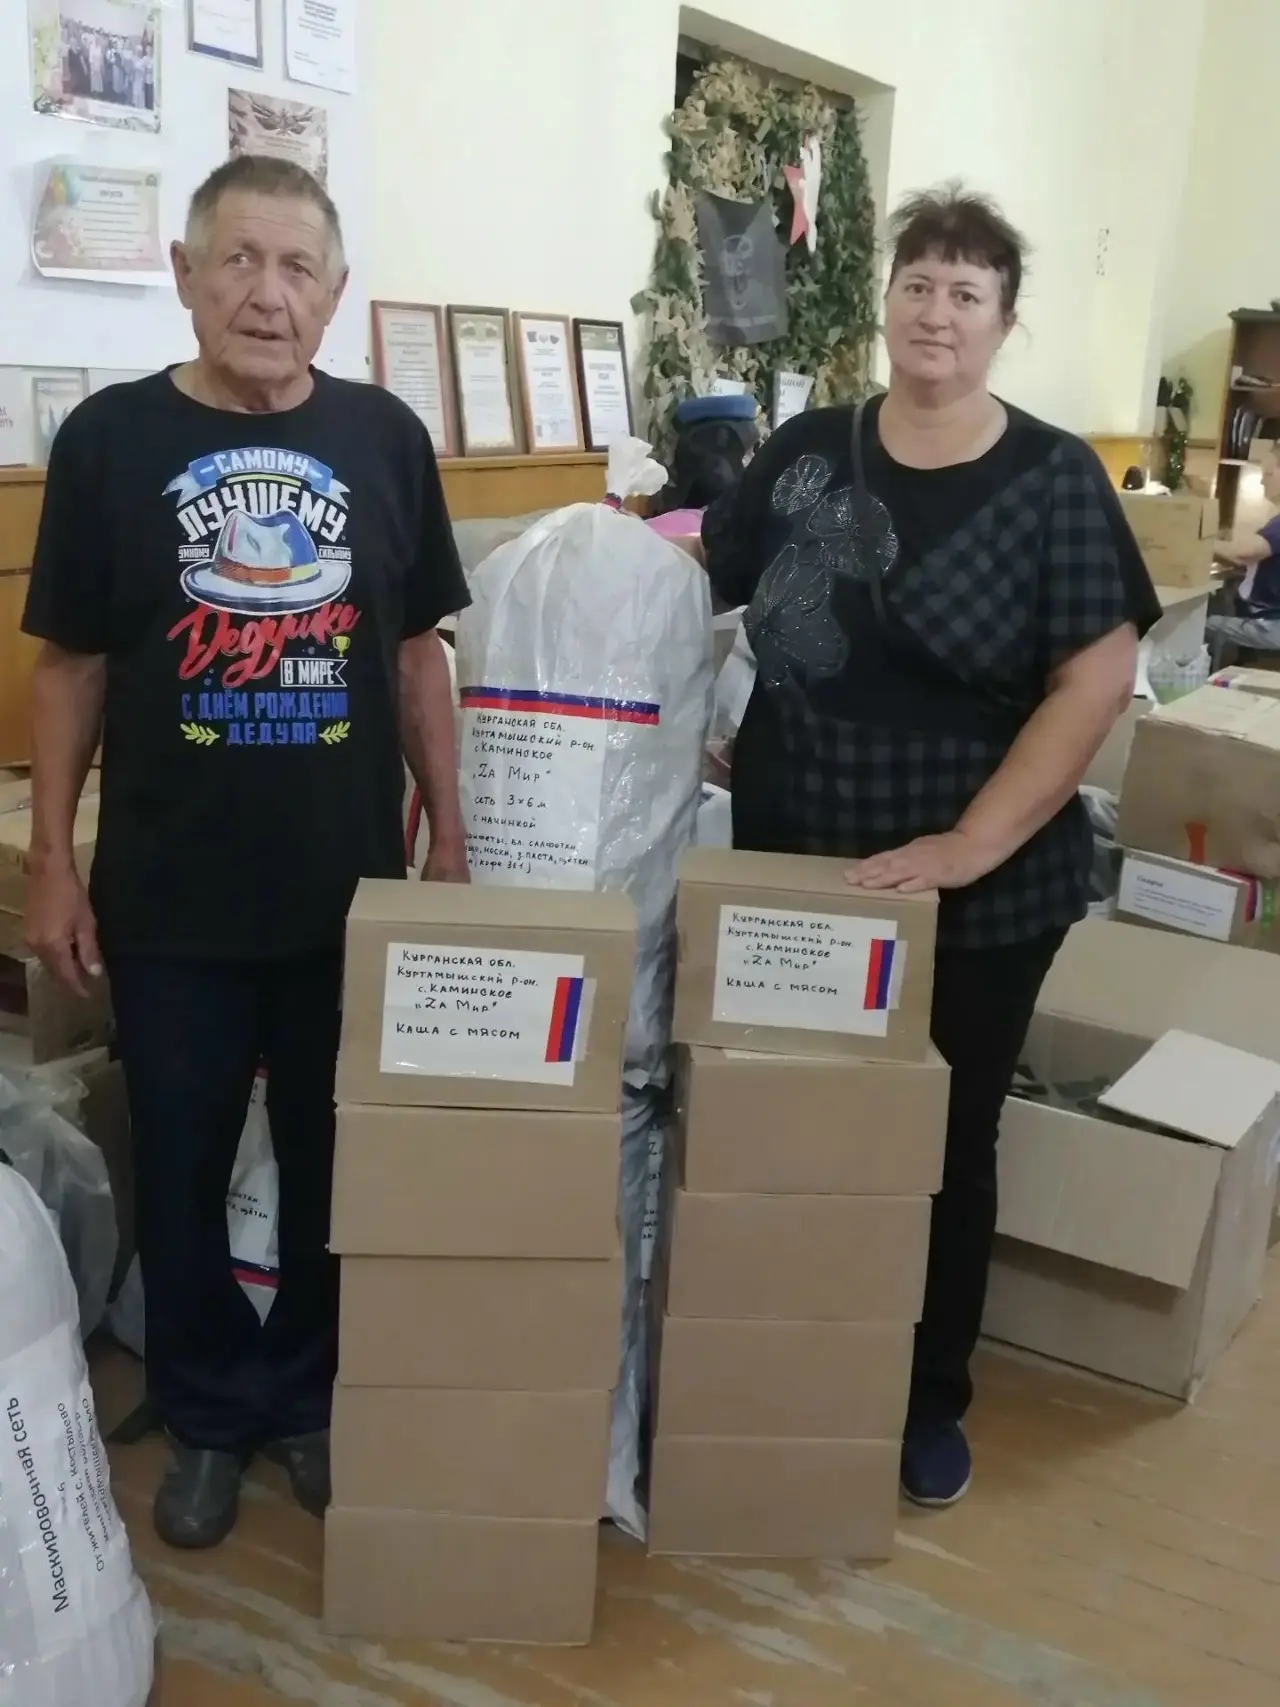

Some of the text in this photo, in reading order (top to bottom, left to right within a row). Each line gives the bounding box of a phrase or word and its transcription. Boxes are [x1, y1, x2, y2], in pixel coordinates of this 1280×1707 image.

[214, 450, 309, 477] САМОМУ
[177, 482, 347, 543] ЛУЧШЕМУ
[284, 660, 335, 685] В МИРЕ
[181, 693, 193, 721] С
[7, 1397, 70, 1614] Маскировочная сеть
[76, 1491, 99, 1552] жителей
